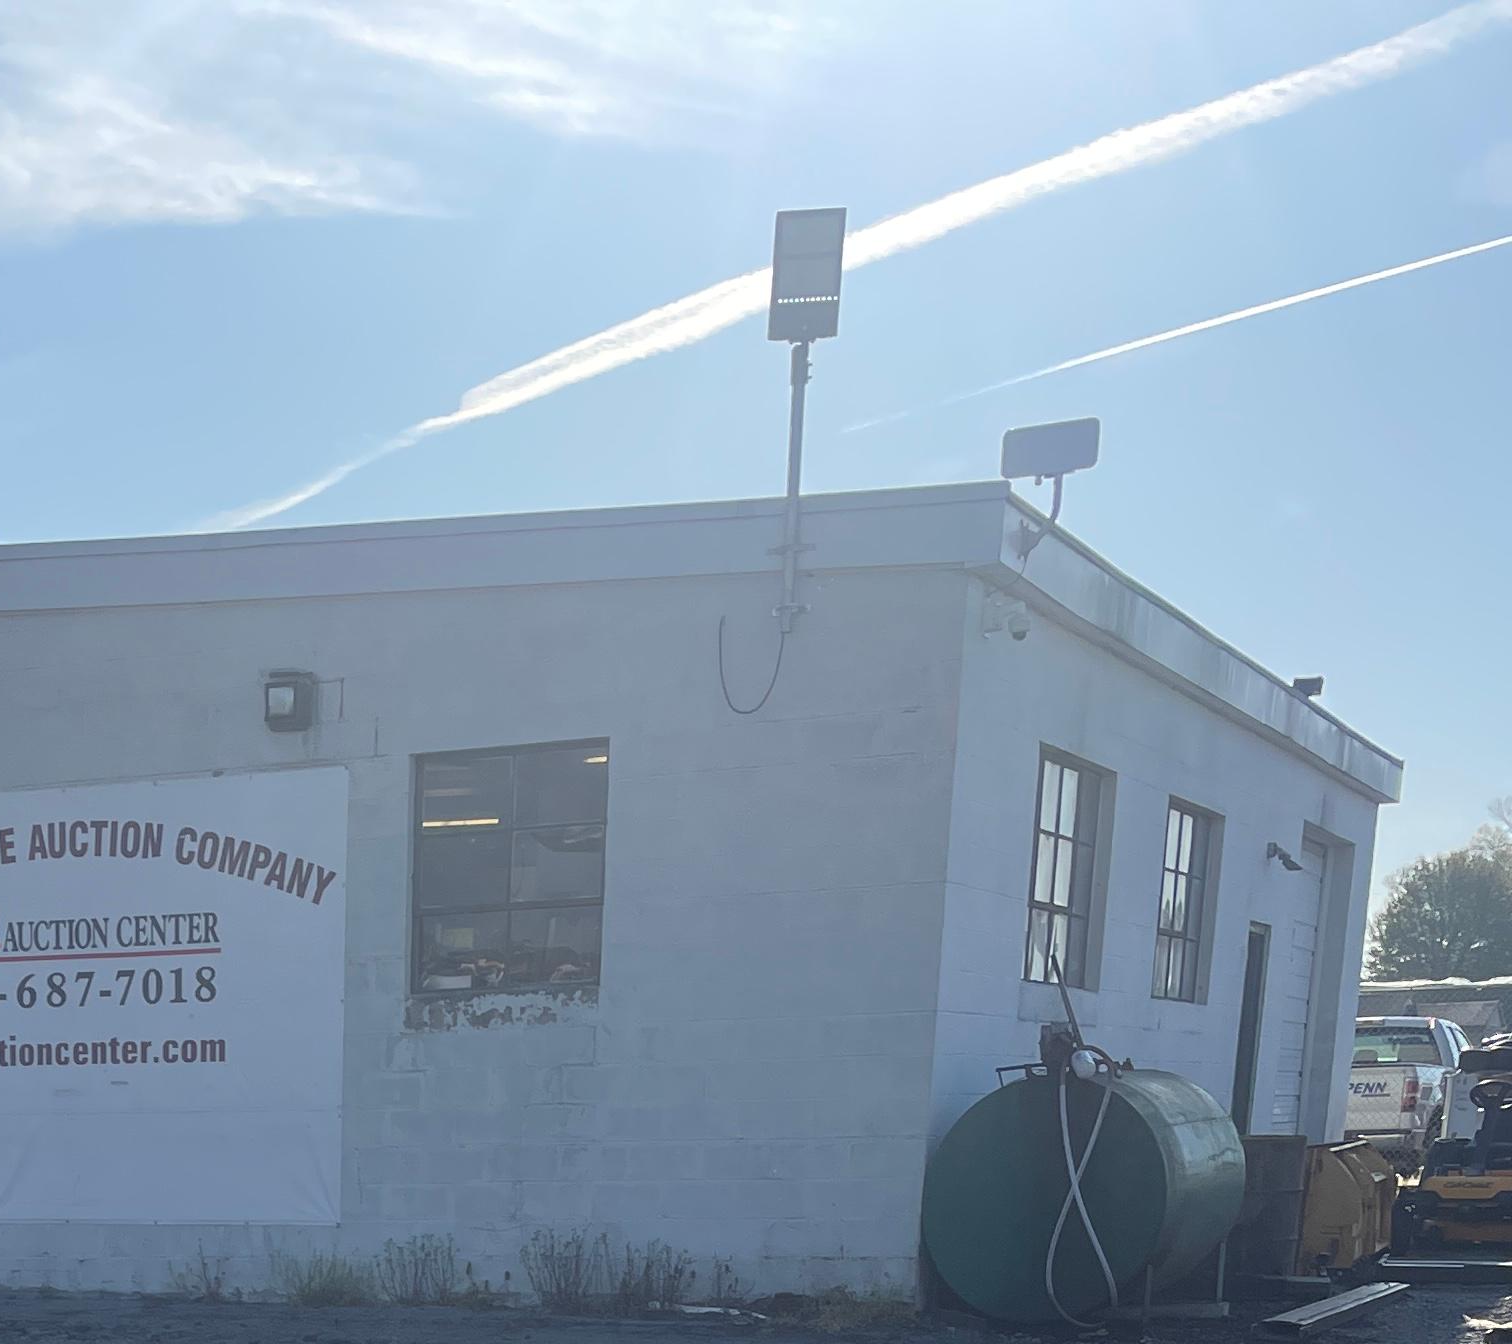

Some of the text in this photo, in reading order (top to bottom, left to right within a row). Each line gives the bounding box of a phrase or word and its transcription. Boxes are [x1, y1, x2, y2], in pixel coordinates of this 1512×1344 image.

[28, 820, 164, 861] AUCTION
[176, 826, 336, 905] COMPANY
[2, 916, 109, 953] AUCTION
[116, 912, 220, 946] CENTER
